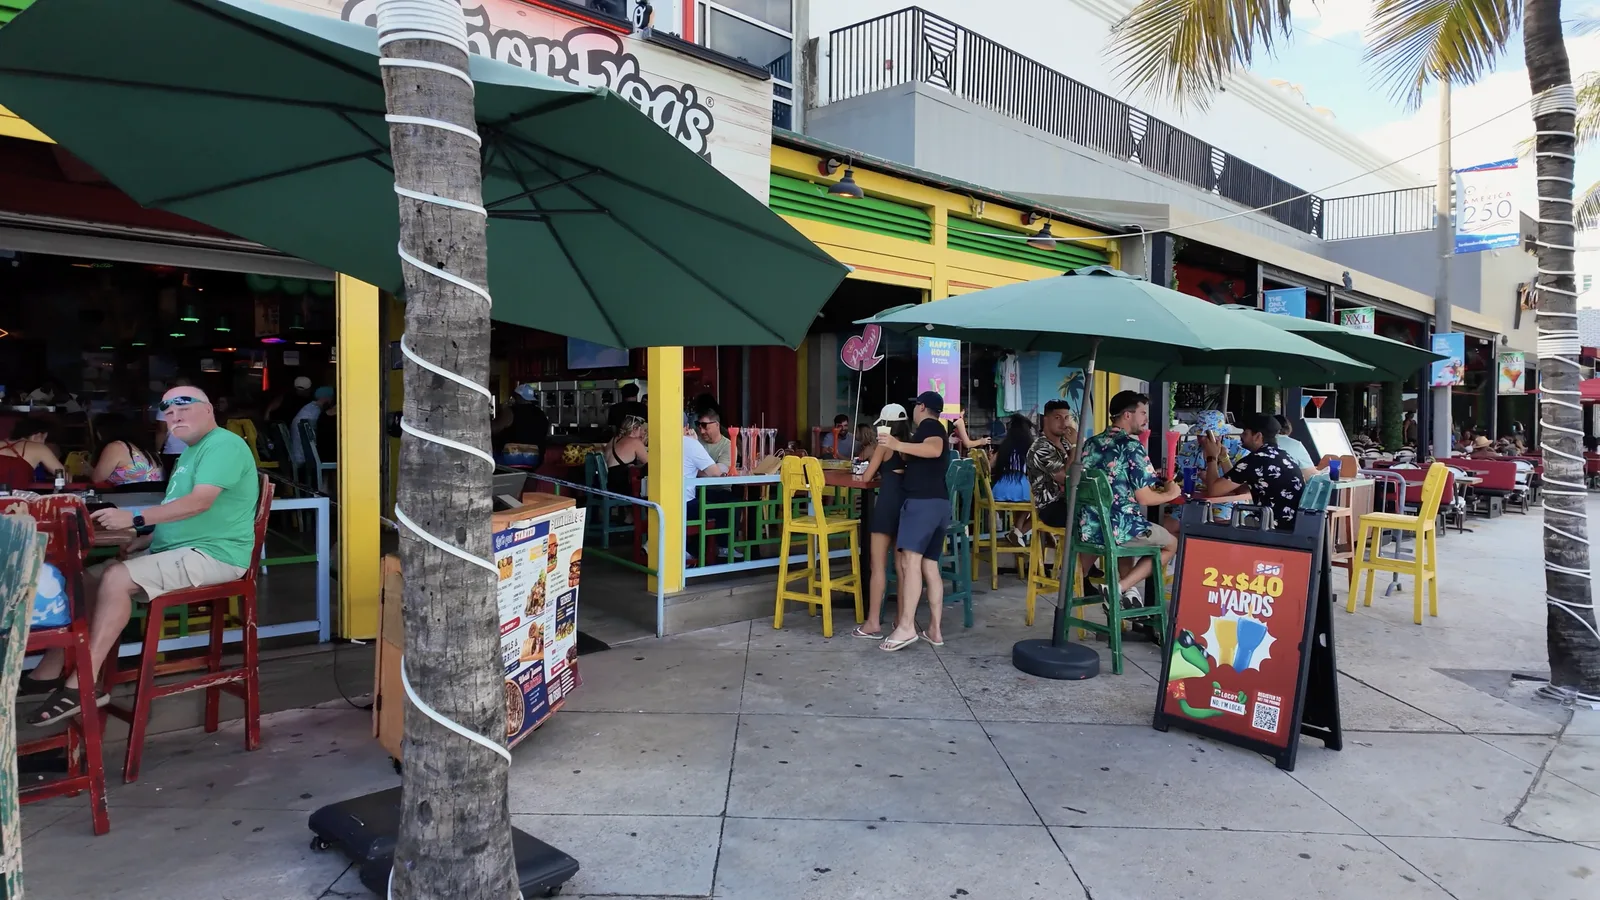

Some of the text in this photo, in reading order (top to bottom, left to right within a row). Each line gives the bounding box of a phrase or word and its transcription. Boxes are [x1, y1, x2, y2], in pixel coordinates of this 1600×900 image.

[1463, 191, 1512, 205] AMERICA
[1463, 199, 1512, 225] 250
[1345, 313, 1371, 326] XXL
[929, 340, 951, 349] HAPPY
[931, 348, 950, 357] HOUR
[1503, 355, 1522, 364] XXL
[1235, 572, 1284, 598] $40
[1207, 587, 1275, 618] IN YARDS
[1228, 703, 1243, 713] LOCAL
